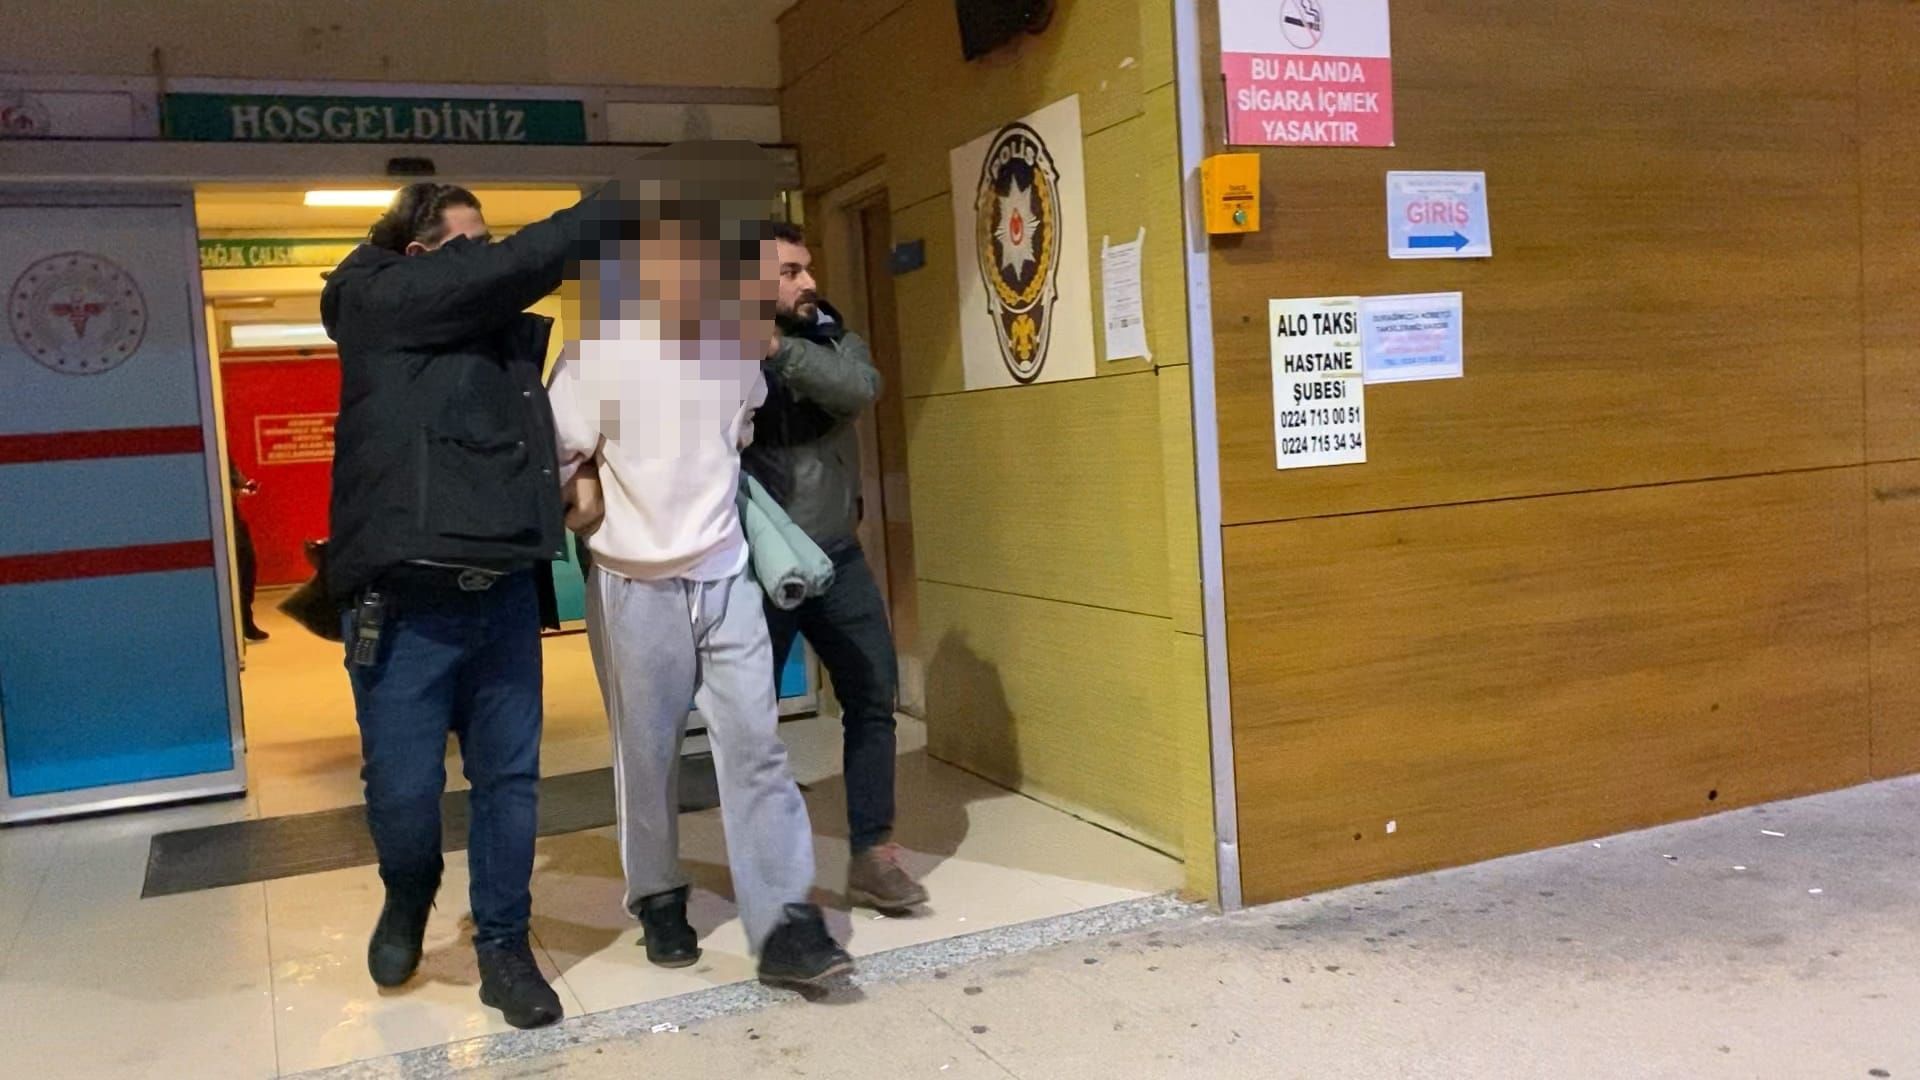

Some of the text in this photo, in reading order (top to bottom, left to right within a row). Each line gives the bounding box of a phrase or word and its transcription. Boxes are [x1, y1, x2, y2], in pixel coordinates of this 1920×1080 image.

[1251, 57, 1366, 83] BU ALANDA
[1237, 84, 1379, 117] SİGARA İÇMEK
[1262, 120, 1359, 142] YASAKTIR
[1277, 313, 1308, 337] ALO
[1284, 352, 1353, 373] HASTANE
[1280, 406, 1360, 428] 0224 713 00 51
[1282, 432, 1362, 455] 0224 715 34 34
